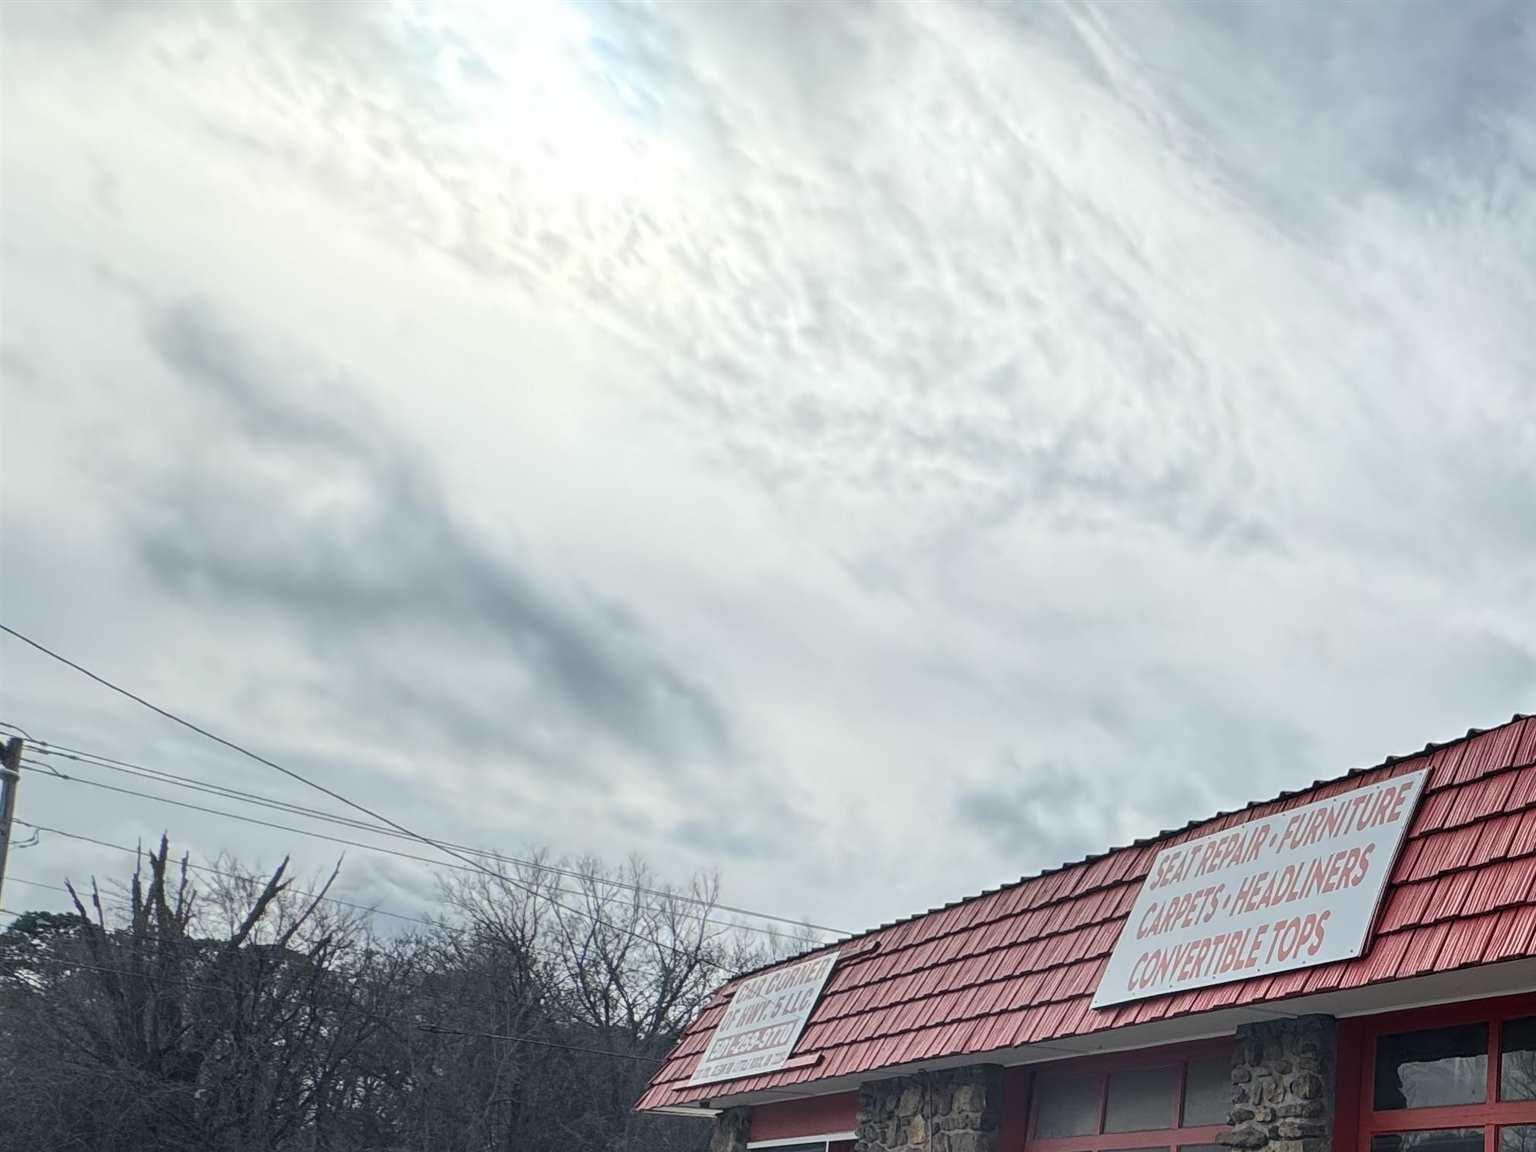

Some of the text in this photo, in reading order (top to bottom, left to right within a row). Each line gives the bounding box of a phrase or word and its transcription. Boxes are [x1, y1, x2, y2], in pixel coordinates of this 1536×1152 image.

[1150, 782, 1413, 890] SEAT REPAIR FURNITURE
[1136, 842, 1376, 940] CARPETS HEADLINERS
[765, 958, 831, 995] CORNER
[1127, 909, 1331, 992] CONVERTIBLE TOPS
